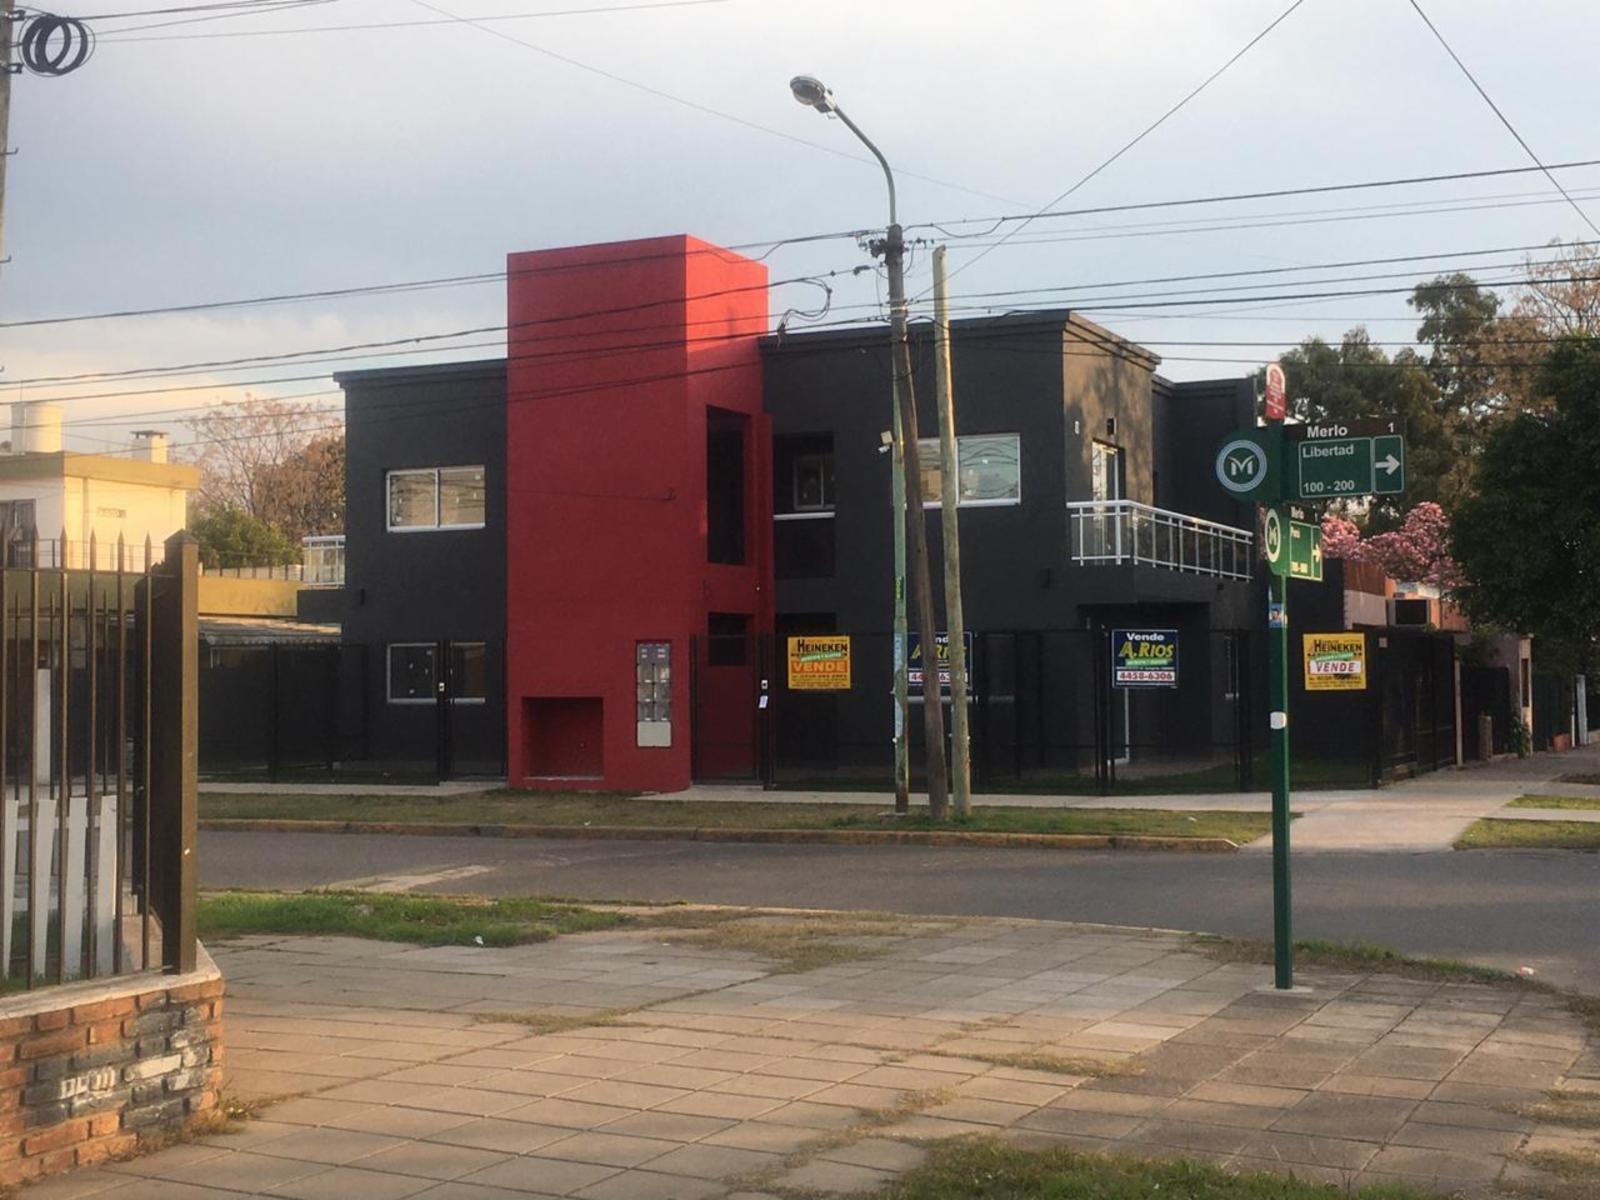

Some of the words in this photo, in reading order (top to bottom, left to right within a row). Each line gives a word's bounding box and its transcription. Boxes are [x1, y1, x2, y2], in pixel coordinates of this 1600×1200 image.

[1307, 425, 1348, 439] Merlo
[1387, 422, 1395, 433] 1
[1302, 444, 1354, 458] Libertad
[1303, 481, 1324, 493] 100
[1333, 480, 1355, 492] 200
[1126, 633, 1165, 641] Vende
[797, 639, 848, 652] HEINEKEN
[1313, 639, 1362, 653] HEINEKEN
[793, 661, 846, 672] VENDE
[1315, 662, 1356, 672] VENDE
